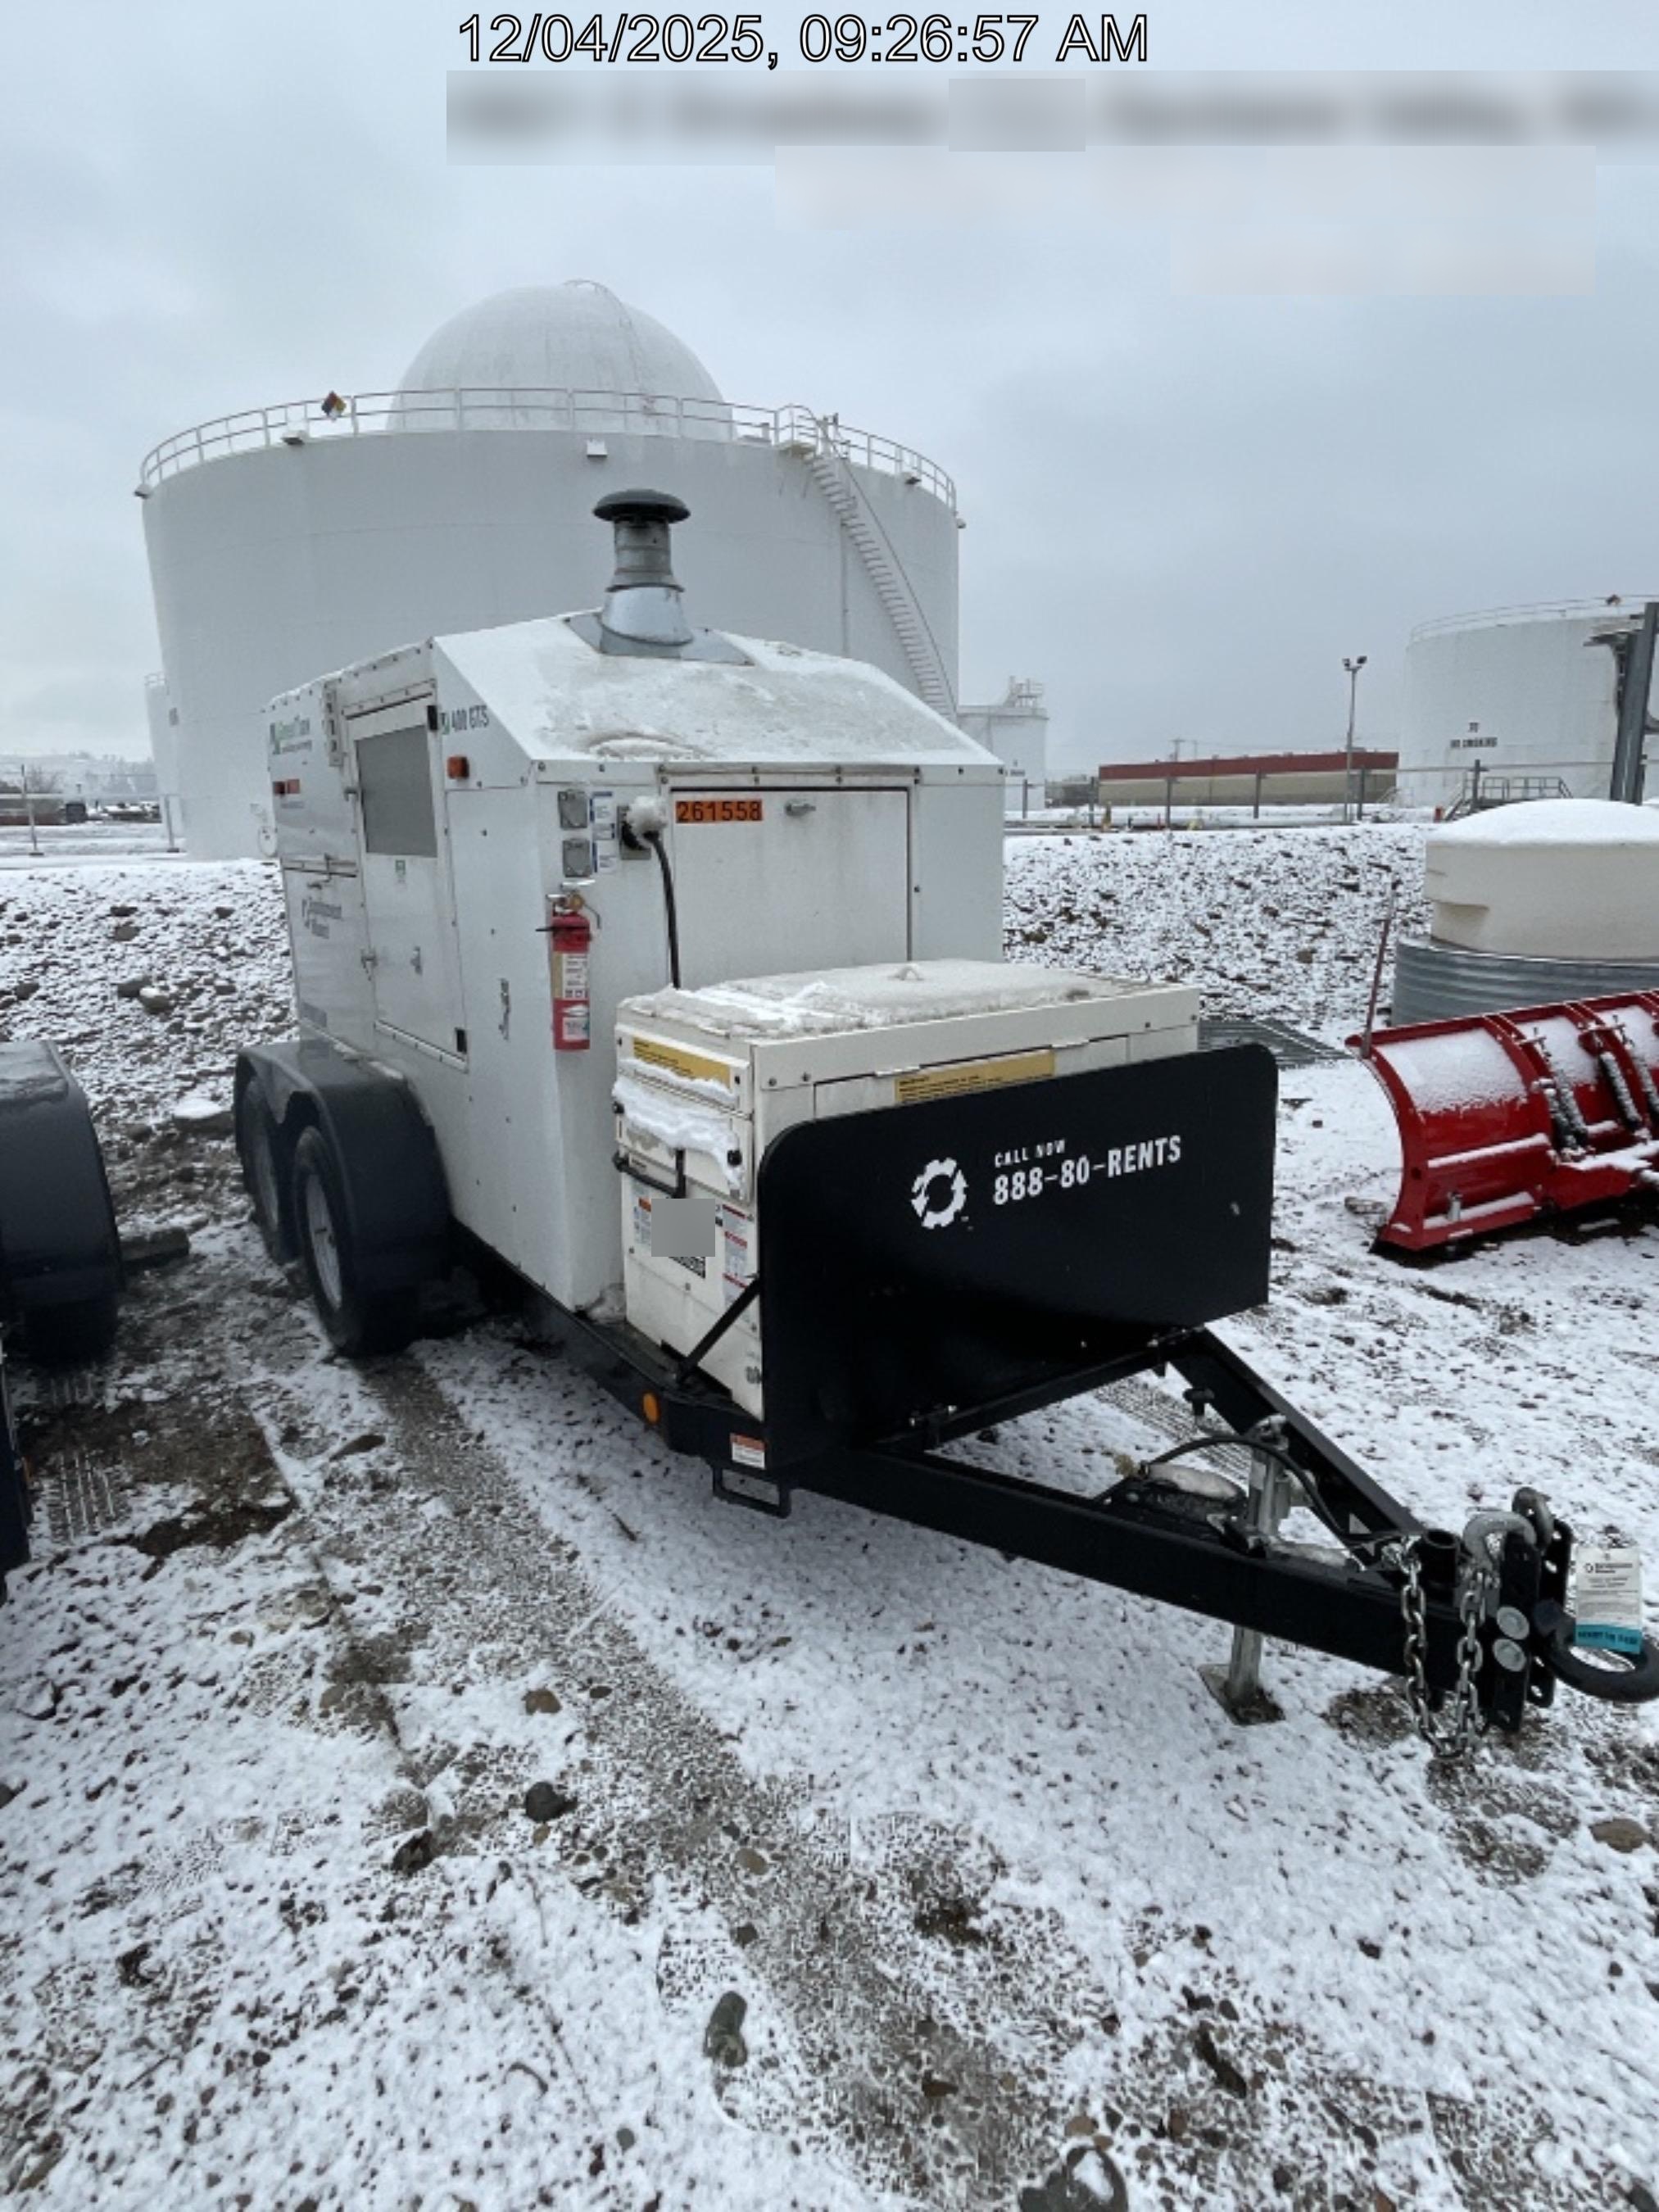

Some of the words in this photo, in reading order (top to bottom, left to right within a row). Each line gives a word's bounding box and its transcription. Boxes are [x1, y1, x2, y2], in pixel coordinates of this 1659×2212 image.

[675, 800, 763, 824] 261558
[994, 1147, 1030, 1168] CALL
[1036, 1138, 1066, 1159] NOW
[992, 1134, 1181, 1206] 888-80-RENTS
